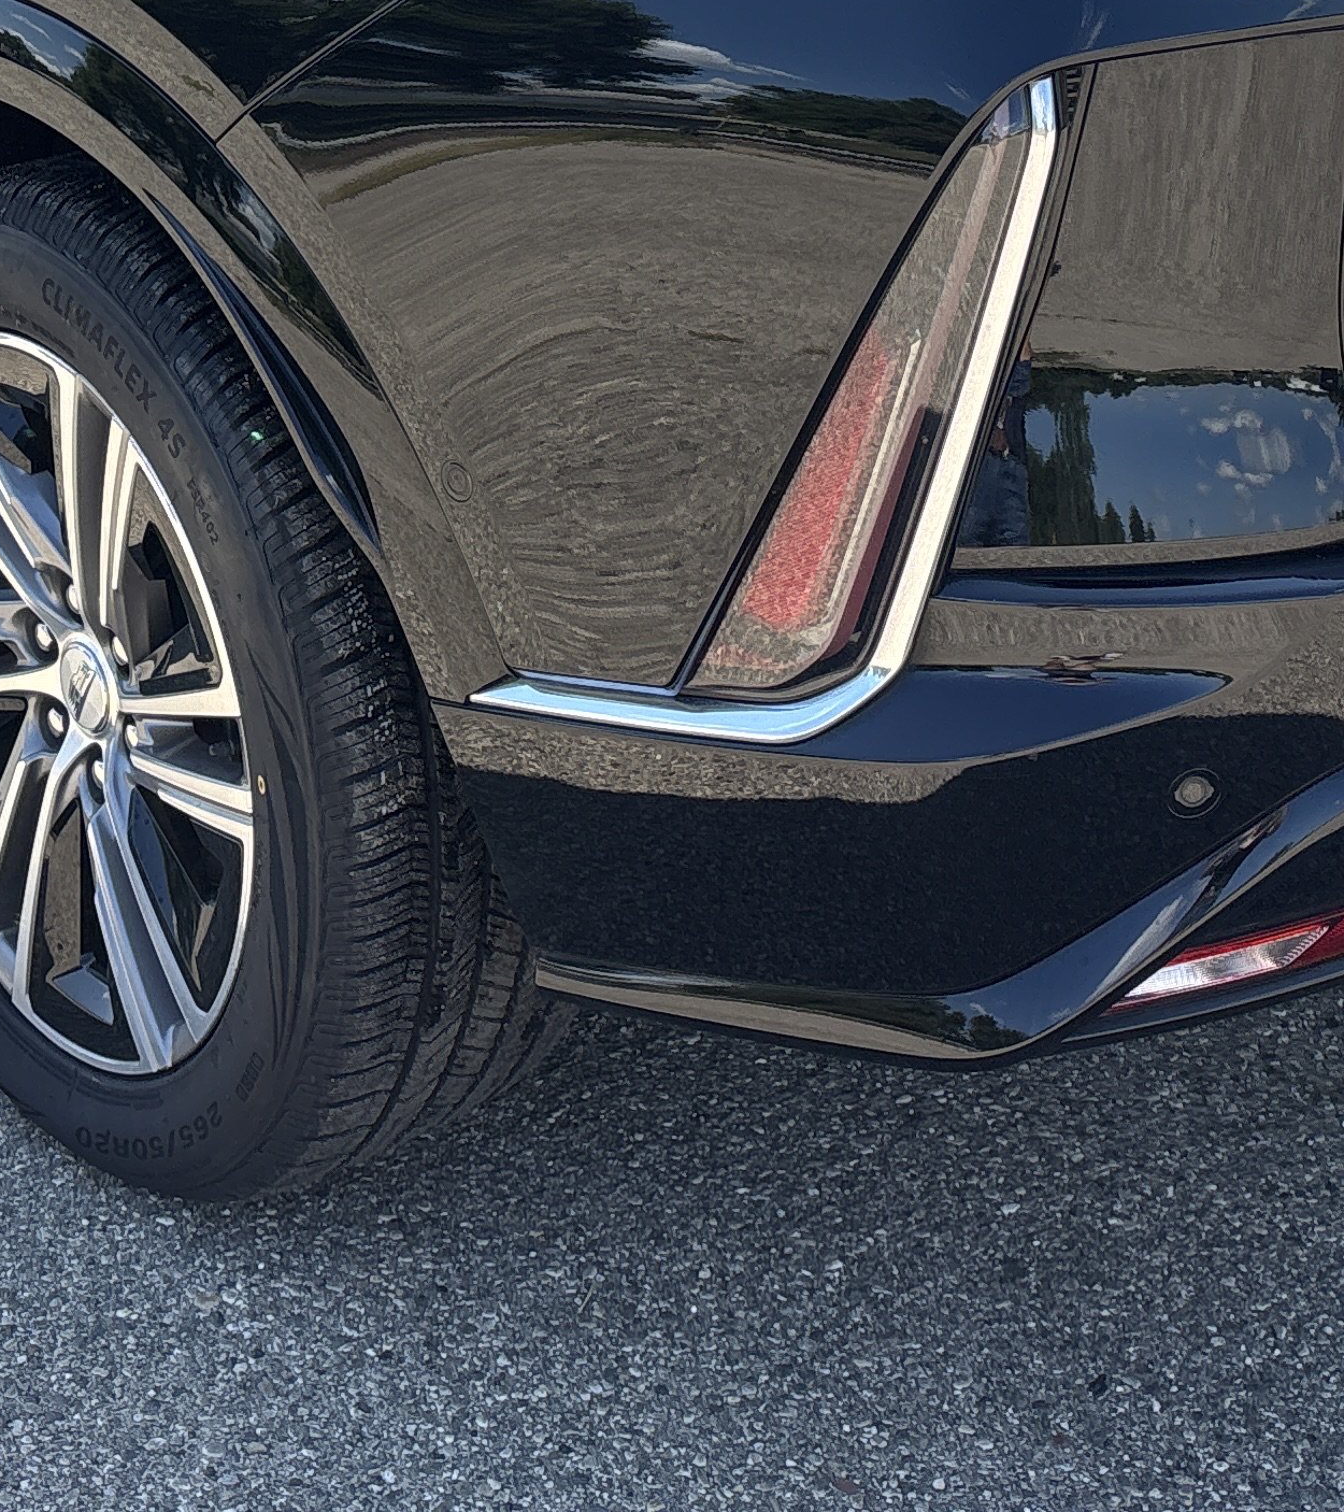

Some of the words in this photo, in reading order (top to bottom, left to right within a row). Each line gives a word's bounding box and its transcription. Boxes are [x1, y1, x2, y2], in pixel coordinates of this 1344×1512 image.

[41, 277, 157, 414] CLIMAFLEX
[157, 417, 186, 459] 4S
[75, 1100, 223, 1160] 265/50R20
